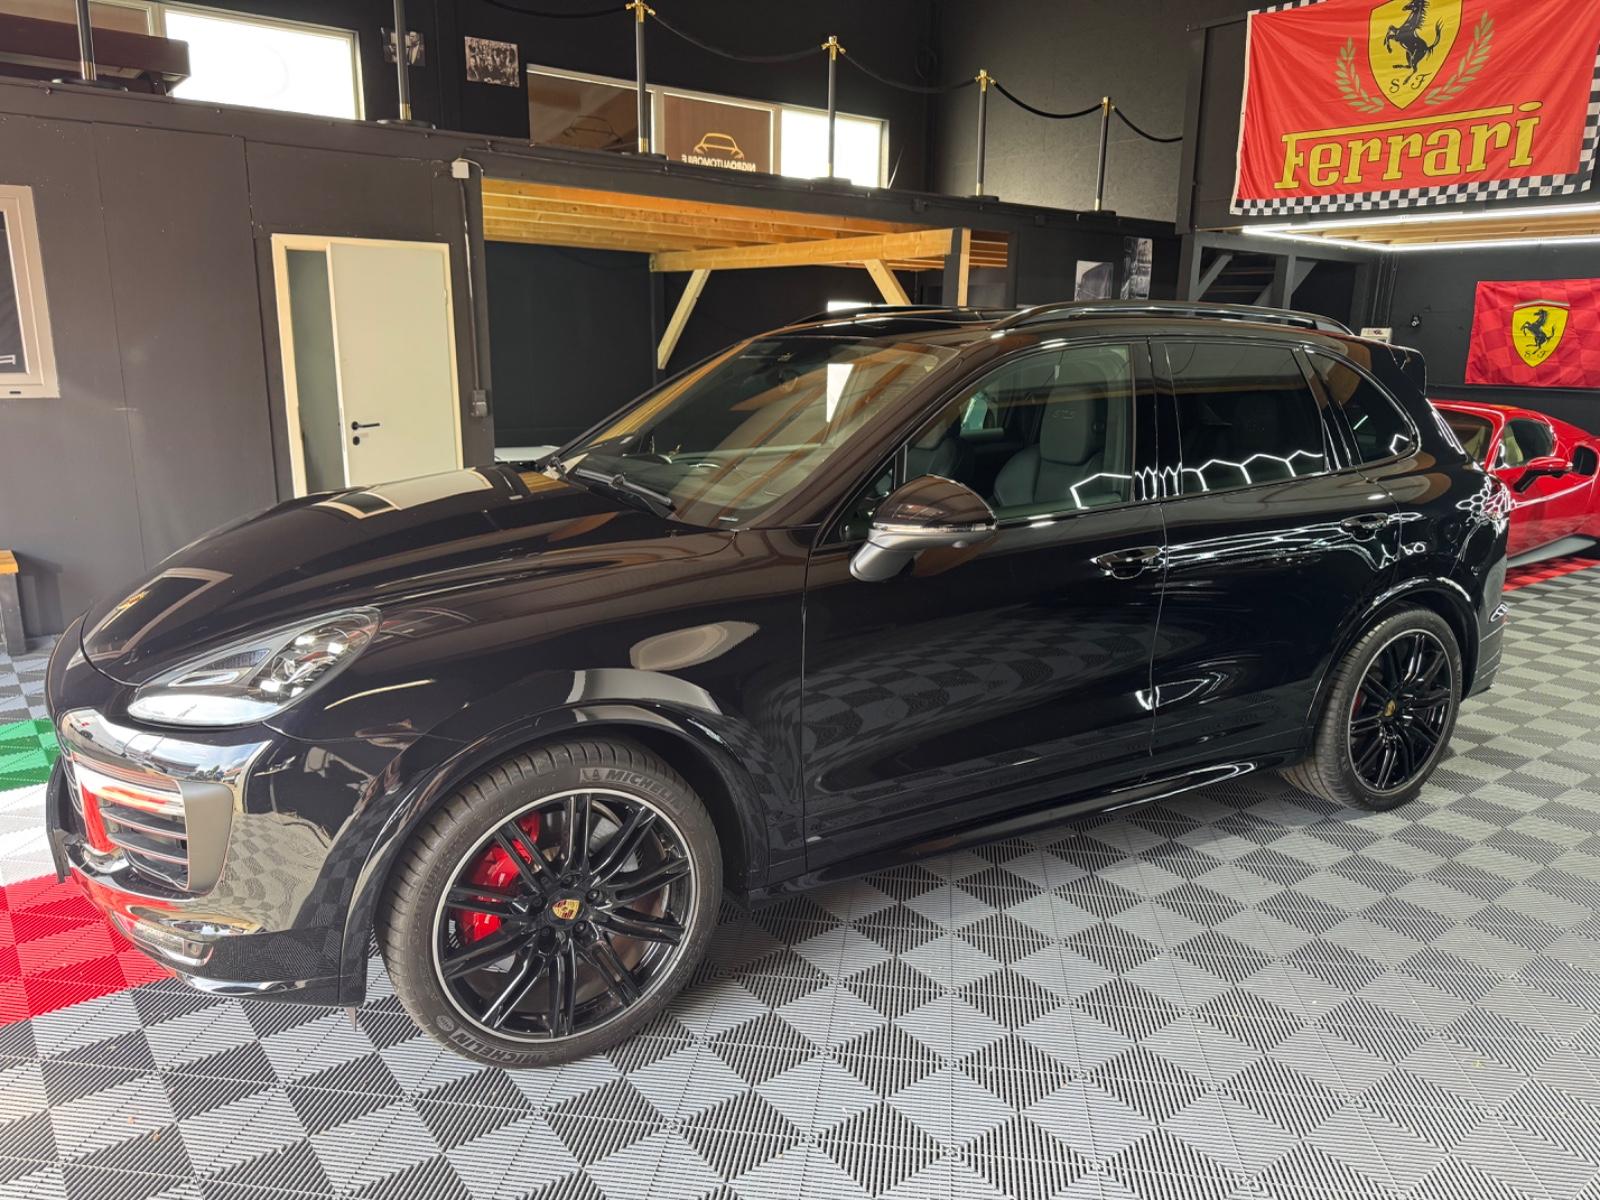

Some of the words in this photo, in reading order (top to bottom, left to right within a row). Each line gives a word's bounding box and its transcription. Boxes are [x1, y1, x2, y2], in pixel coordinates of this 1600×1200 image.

[1389, 78, 1400, 94] S
[1273, 100, 1544, 190] Ferrari
[452, 1032, 545, 1064] MICHELIN
